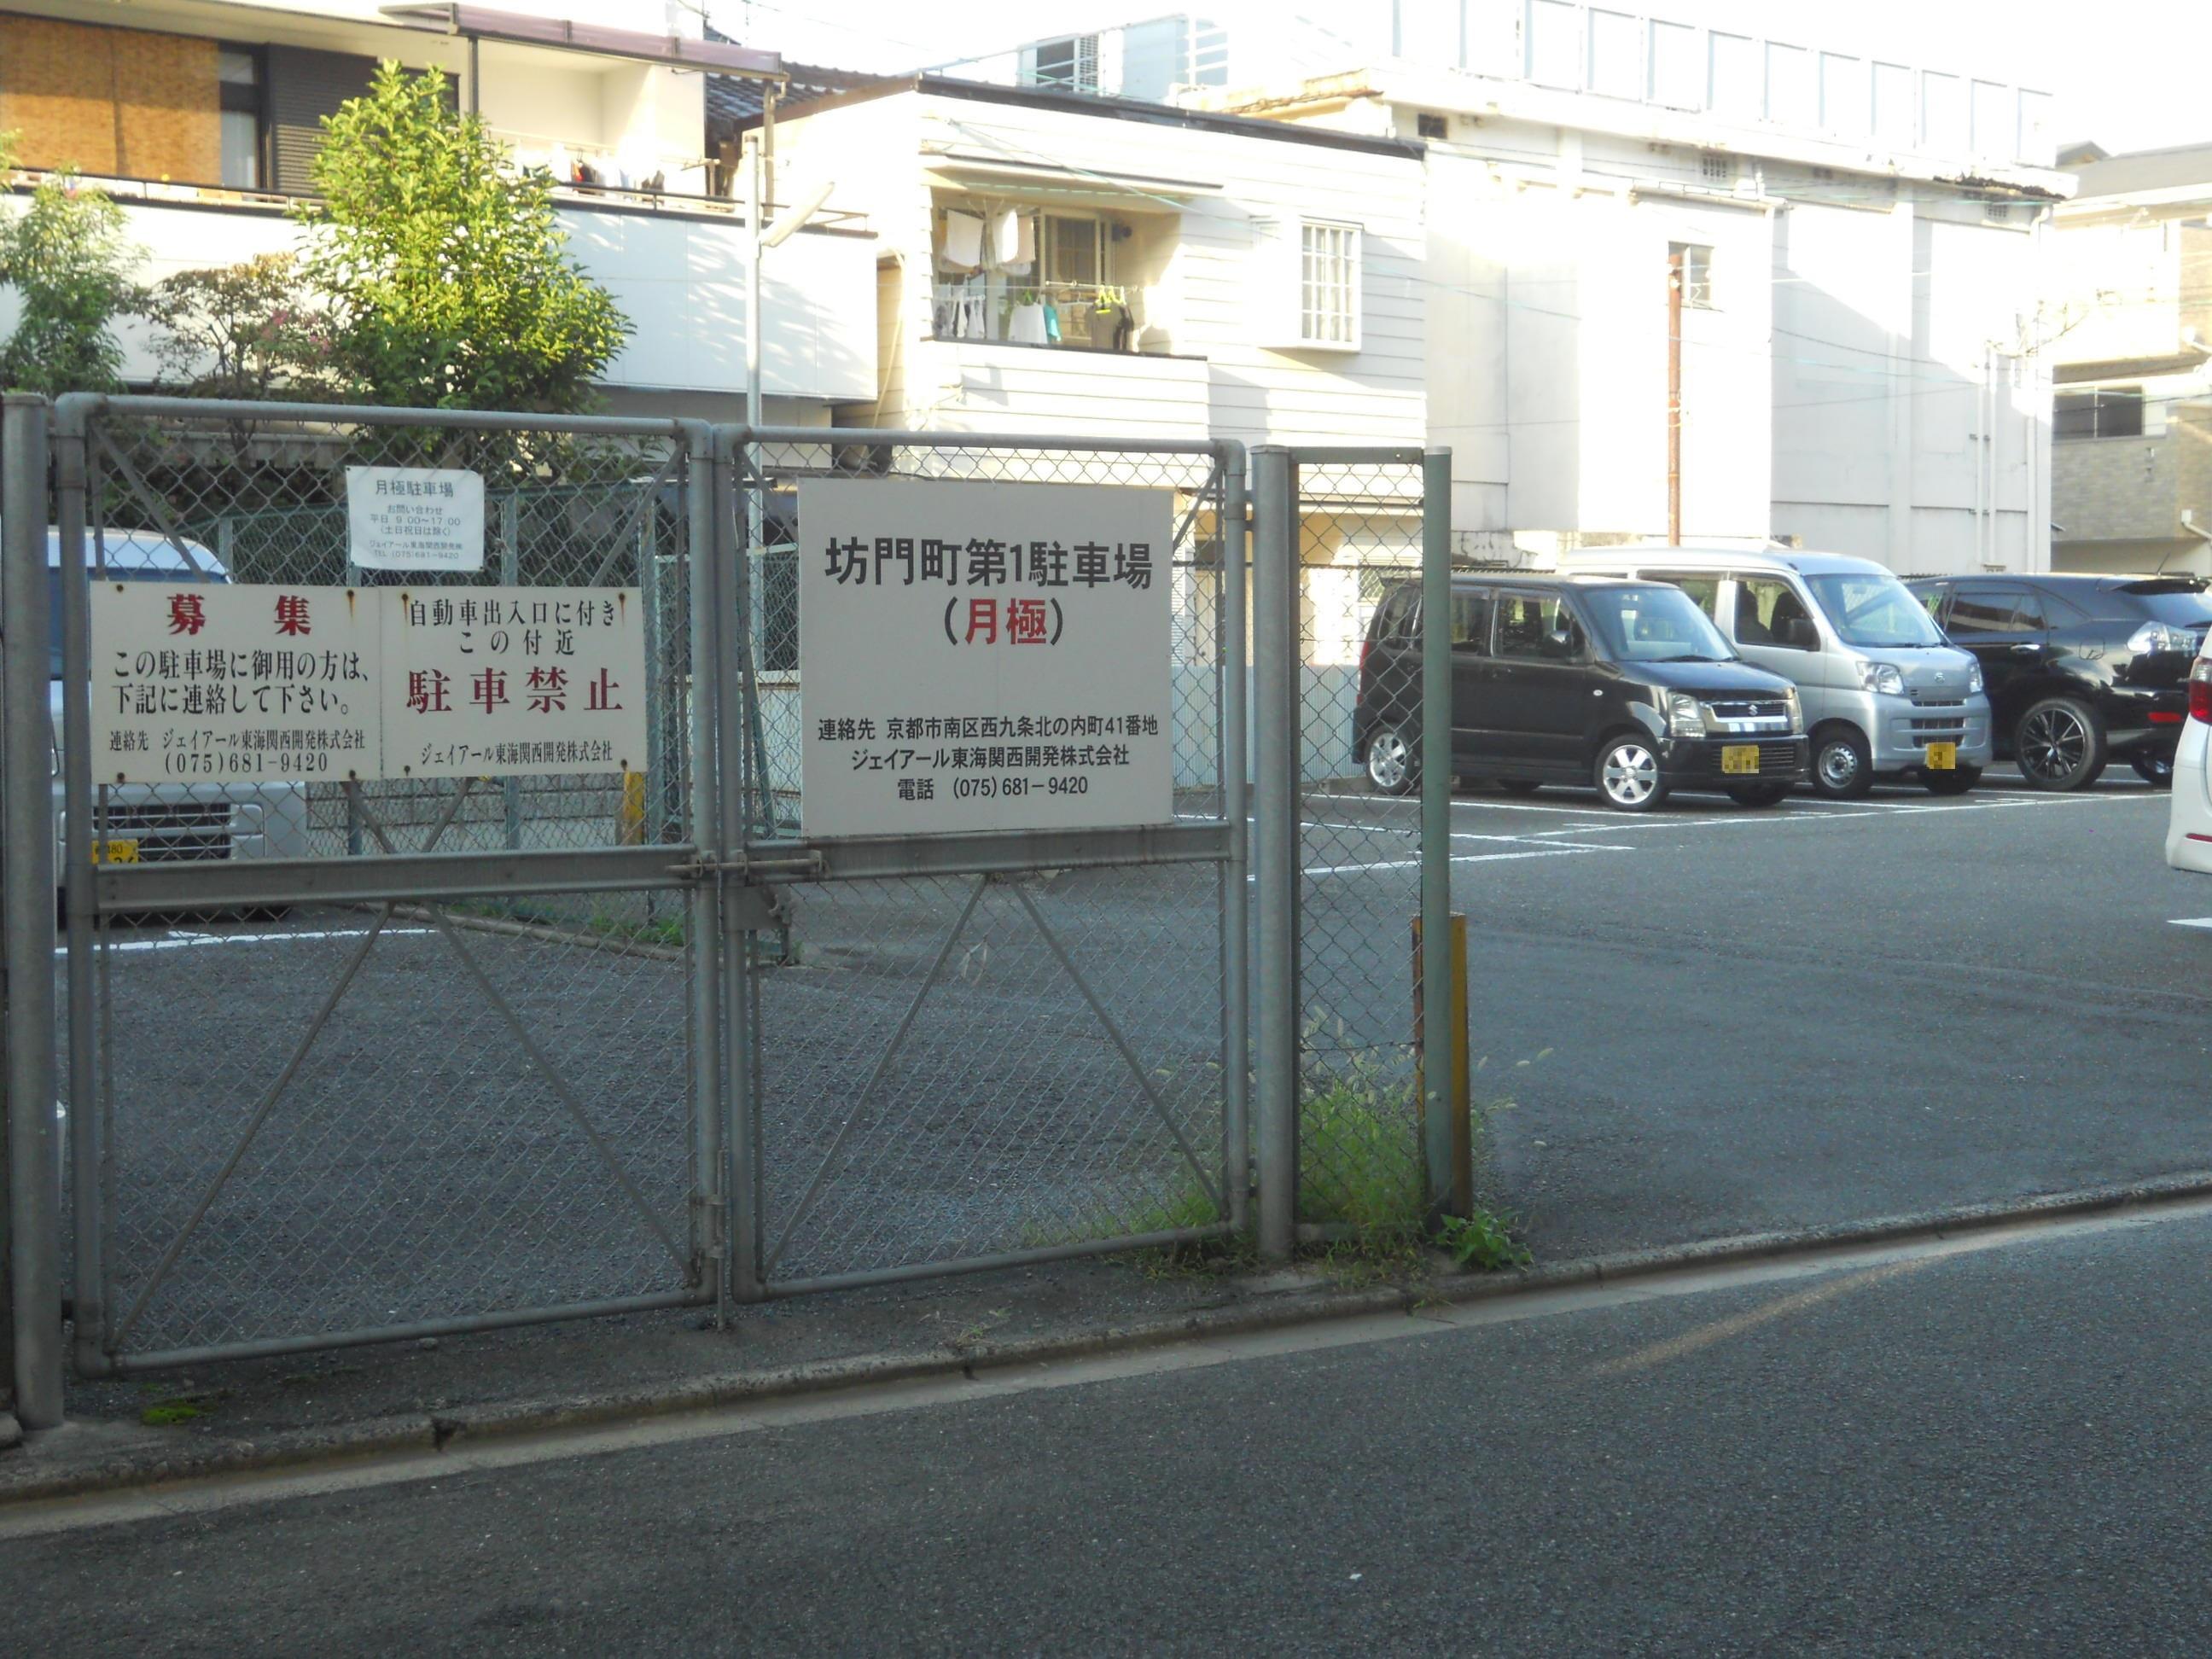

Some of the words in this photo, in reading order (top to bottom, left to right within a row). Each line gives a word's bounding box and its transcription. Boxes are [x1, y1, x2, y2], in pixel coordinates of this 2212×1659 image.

[375, 480, 454, 498] 月極駐車場
[370, 514, 389, 524] 平日
[387, 504, 443, 515] お問い合わせ
[824, 537, 1153, 591] 坊門町第1駐車場
[410, 598, 615, 627] 自動車出入口に付き
[944, 597, 1064, 646] (月極)
[460, 628, 575, 656] この付近
[114, 649, 370, 683] この駐車場に御用の方は、
[111, 683, 349, 715] 下記に連絡して下さい。
[406, 666, 623, 714] 駐車禁止
[109, 730, 149, 752] 連絡先
[162, 729, 366, 751] ジェイアール東海関西開発株式会社
[818, 717, 876, 742] 連絡先
[886, 714, 1159, 740] 京都市南区西九条北の内町41番地
[165, 752, 328, 774] (075)681-9420
[421, 739, 613, 766] ジェイアール東海関西開発株式会社
[851, 743, 1131, 771] ジェイアール東海関西開発株式会社
[897, 777, 934, 801] 電話
